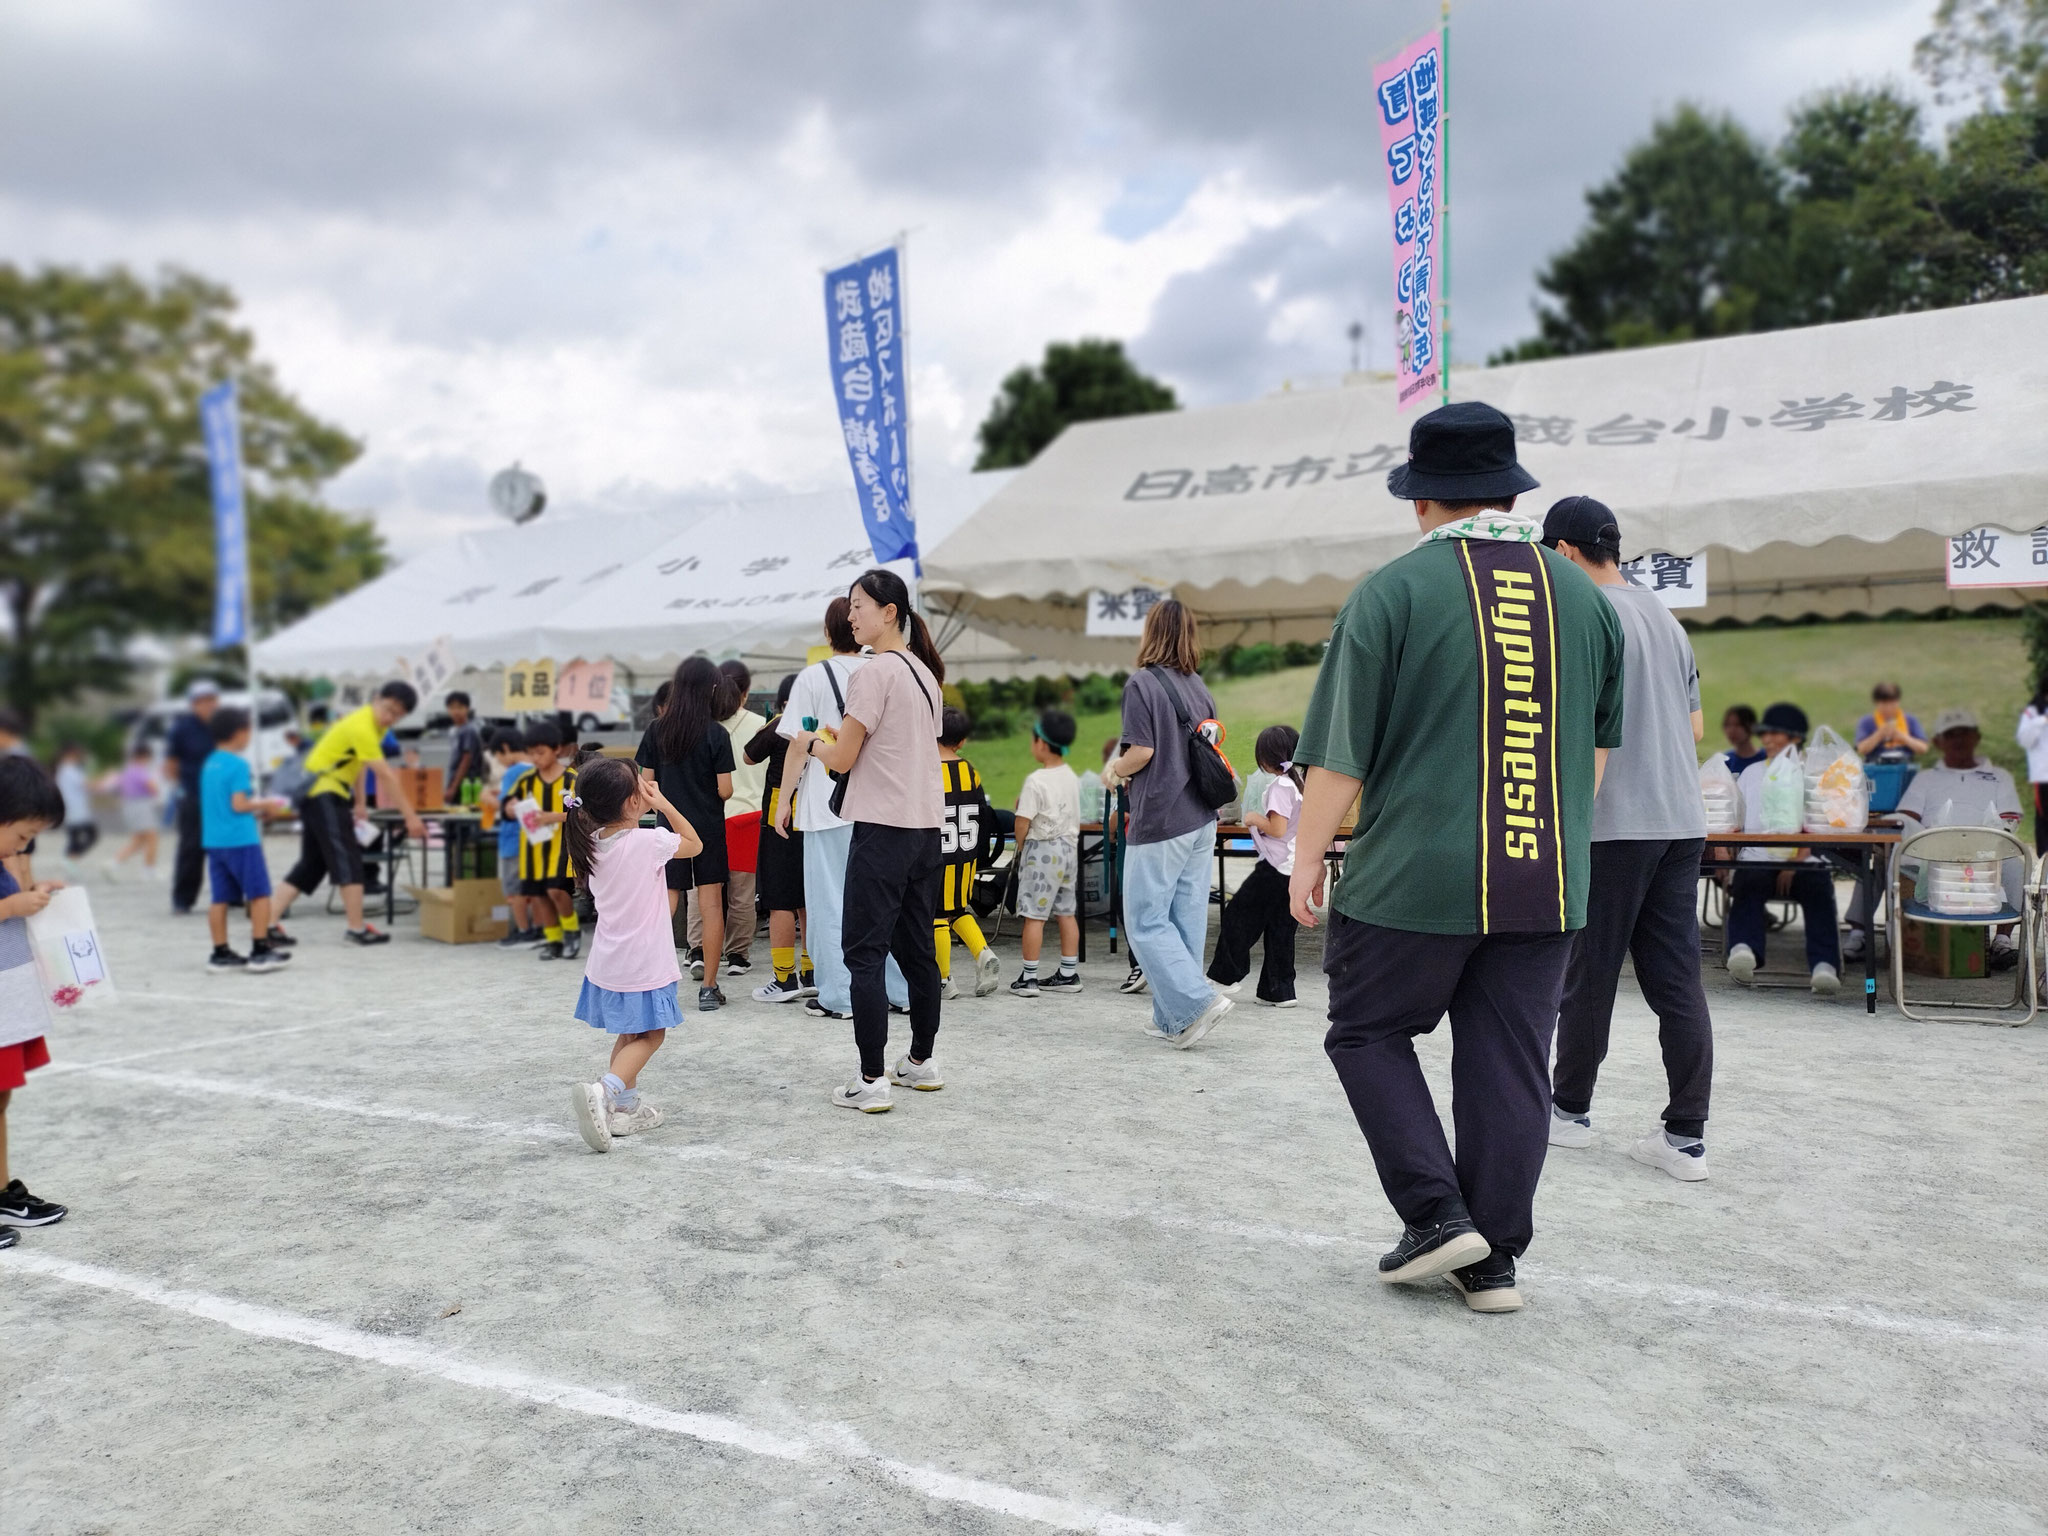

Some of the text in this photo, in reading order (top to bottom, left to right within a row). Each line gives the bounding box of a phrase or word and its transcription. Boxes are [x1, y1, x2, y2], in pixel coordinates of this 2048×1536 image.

[1124, 381, 1977, 502] 日高市立蔵台小学校
[509, 672, 550, 697] 賞品
[1492, 569, 1544, 860] Hypothesis
[941, 804, 980, 854] 55
